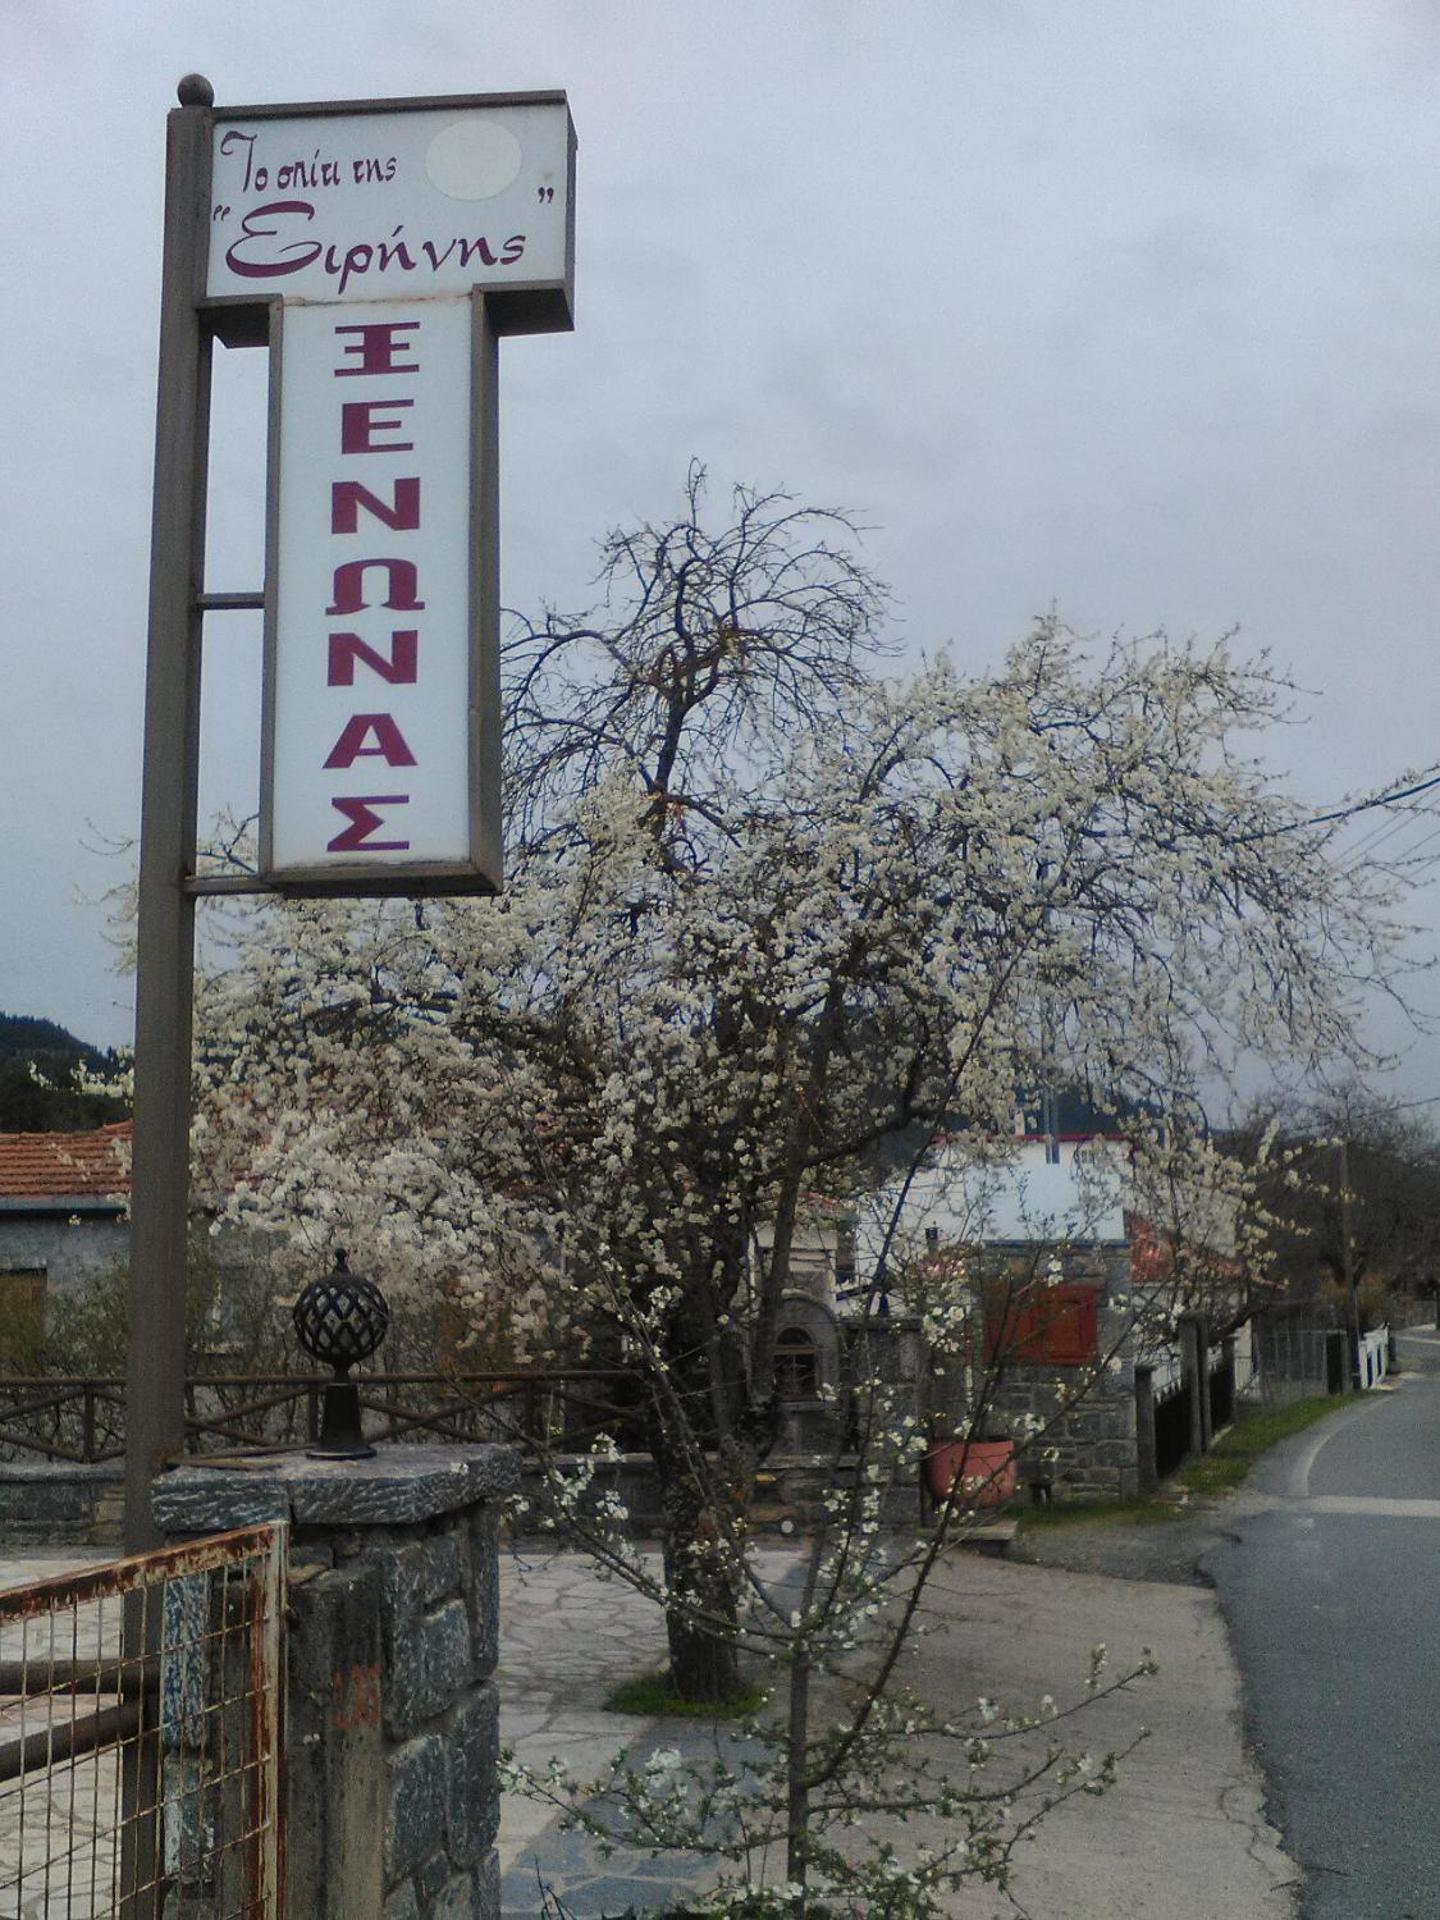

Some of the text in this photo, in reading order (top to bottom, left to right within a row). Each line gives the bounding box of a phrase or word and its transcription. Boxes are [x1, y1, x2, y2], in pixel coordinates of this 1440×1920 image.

[220, 130, 397, 192] Το σπίτι της
[322, 321, 426, 853] ΞΕΝΩΝΑΣ
